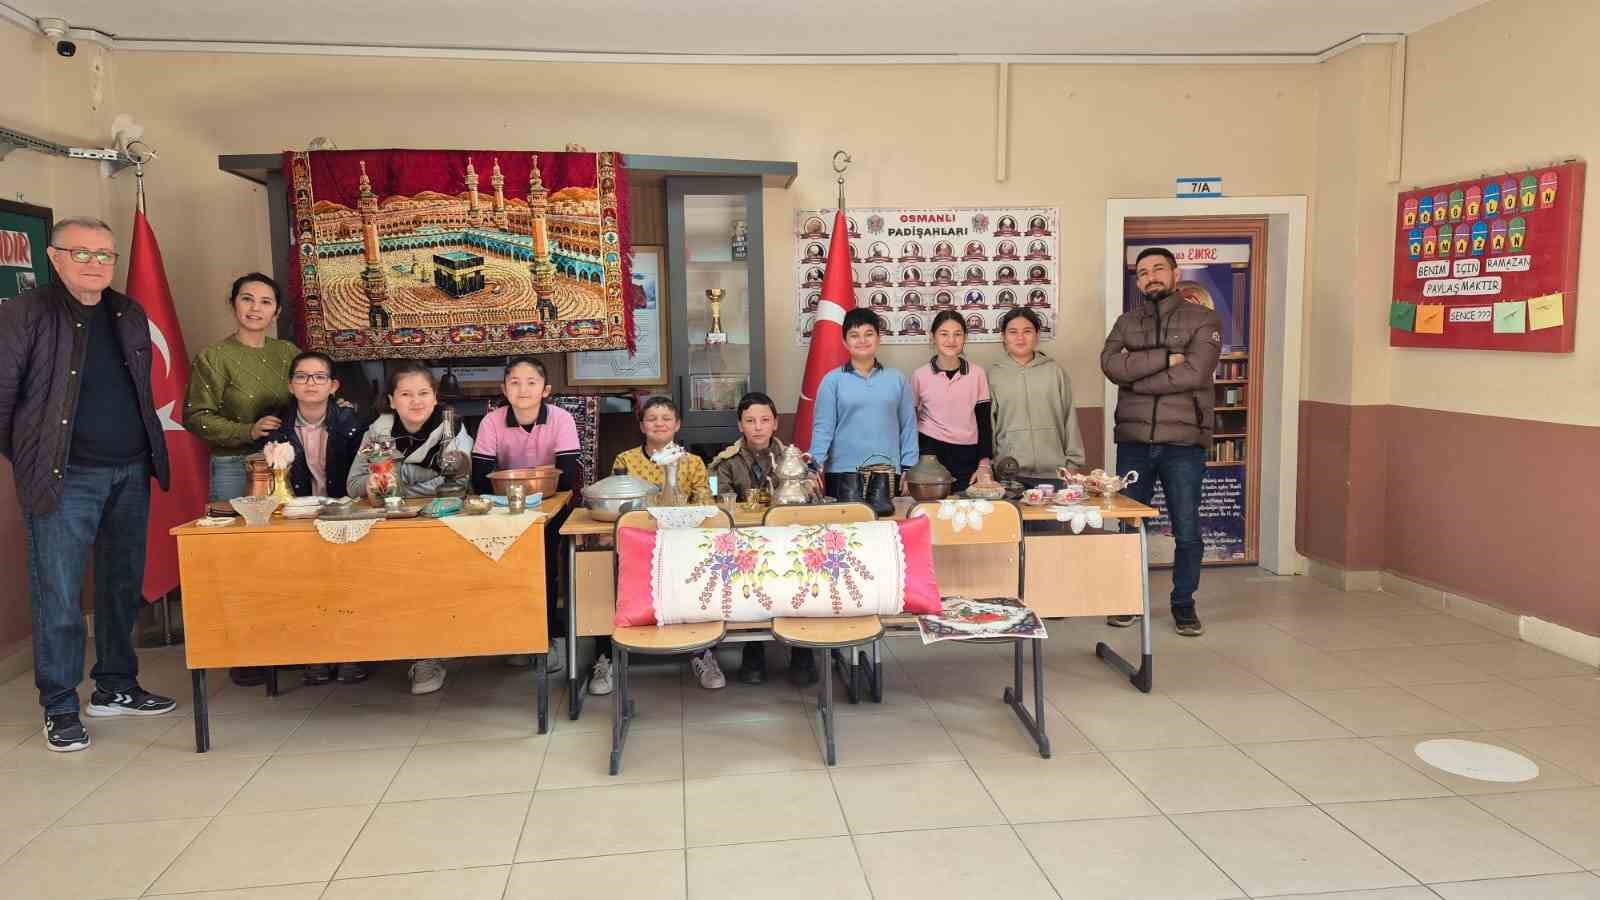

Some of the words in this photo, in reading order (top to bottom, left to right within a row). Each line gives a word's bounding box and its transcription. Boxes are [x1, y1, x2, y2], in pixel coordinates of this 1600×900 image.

[1191, 182, 1211, 193] 7/A
[899, 214, 956, 223] OSMANLI
[888, 225, 969, 239] PADİŞAHLARI
[1487, 257, 1531, 268] RAMAZAN
